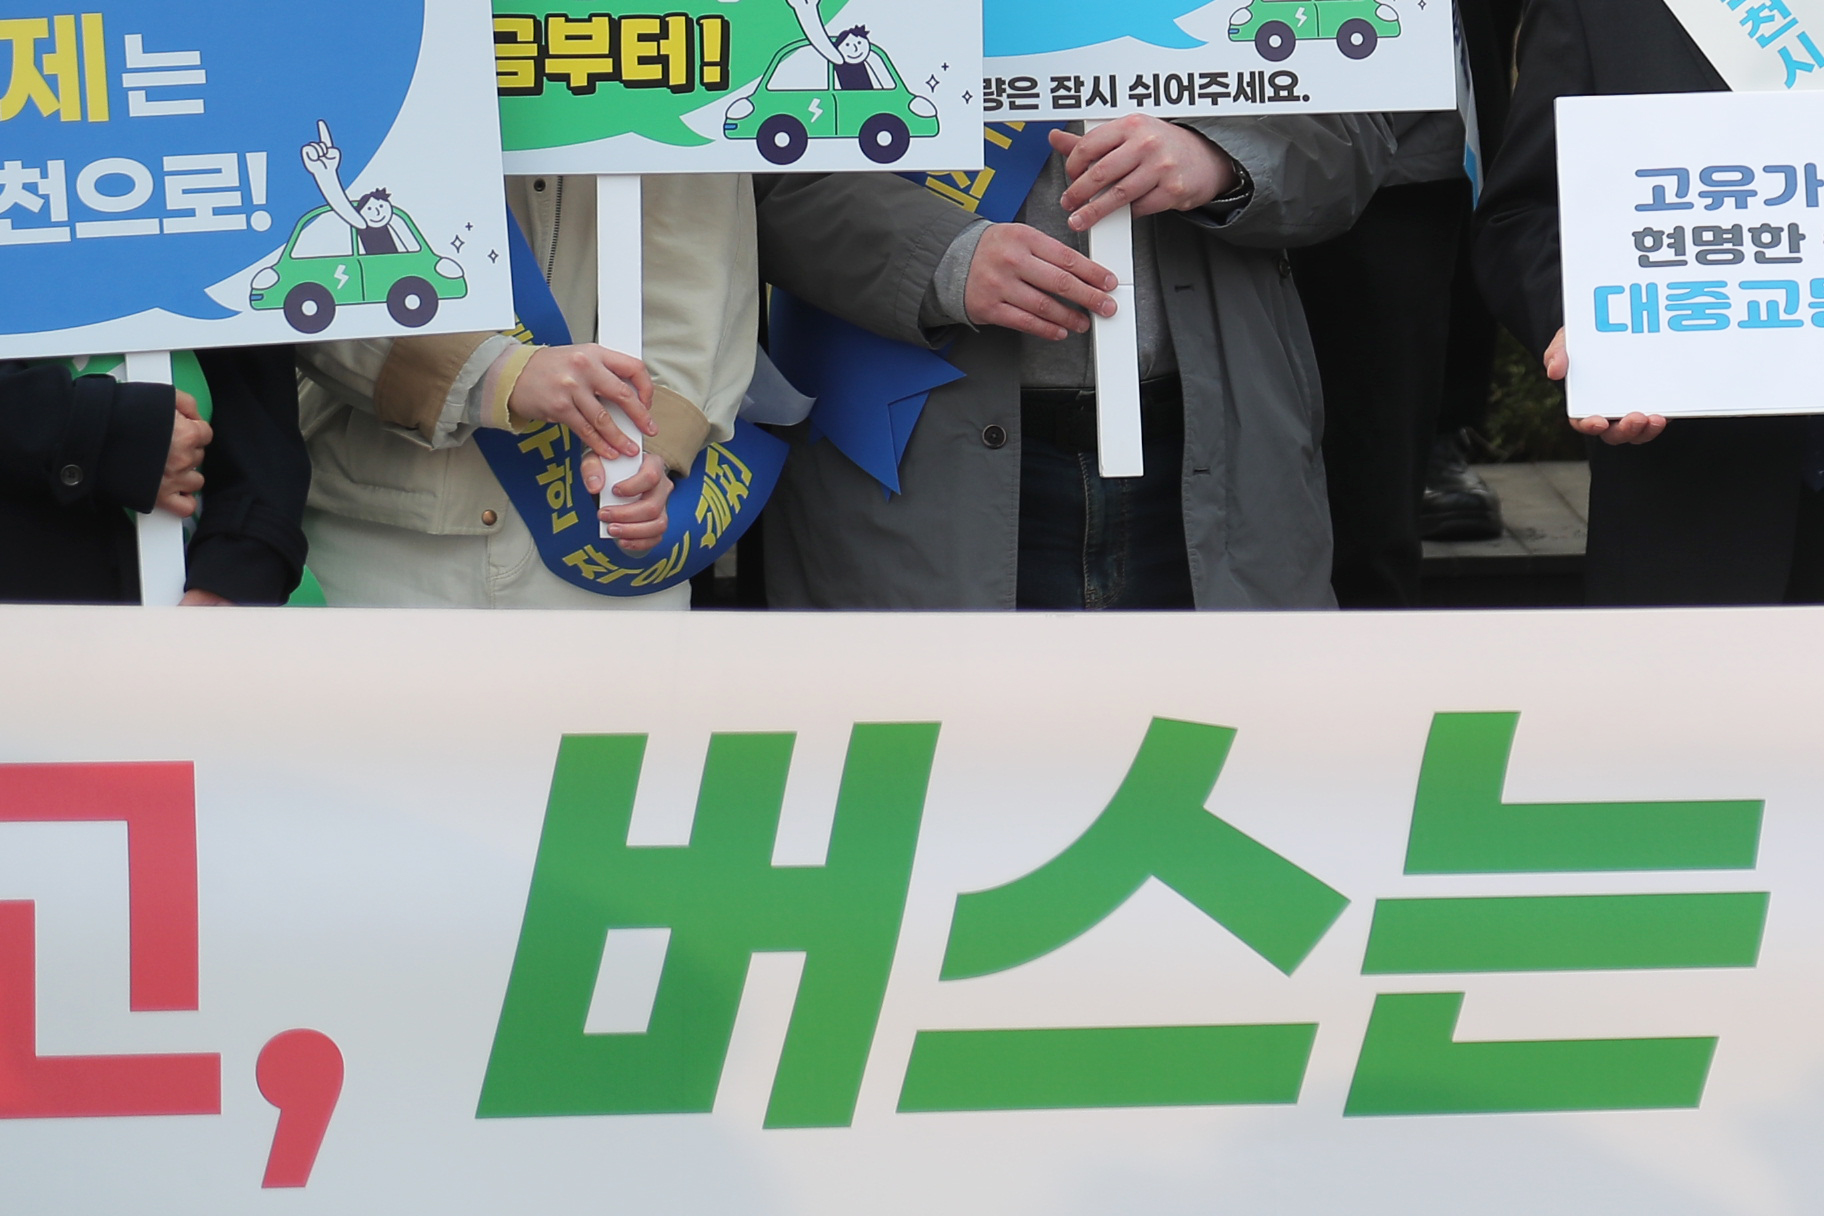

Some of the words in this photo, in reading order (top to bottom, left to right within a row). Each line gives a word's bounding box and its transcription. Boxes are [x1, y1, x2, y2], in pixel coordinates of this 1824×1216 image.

[492, 12, 730, 96] 금부터!
[983, 76, 1041, 113] 량은
[1048, 74, 1119, 111] 잠시
[1127, 69, 1311, 108] 쉬어주세요.
[0, 151, 273, 246] 천으로!
[1630, 221, 1807, 269] 현명한
[474, 709, 1772, 1132] 버스는
